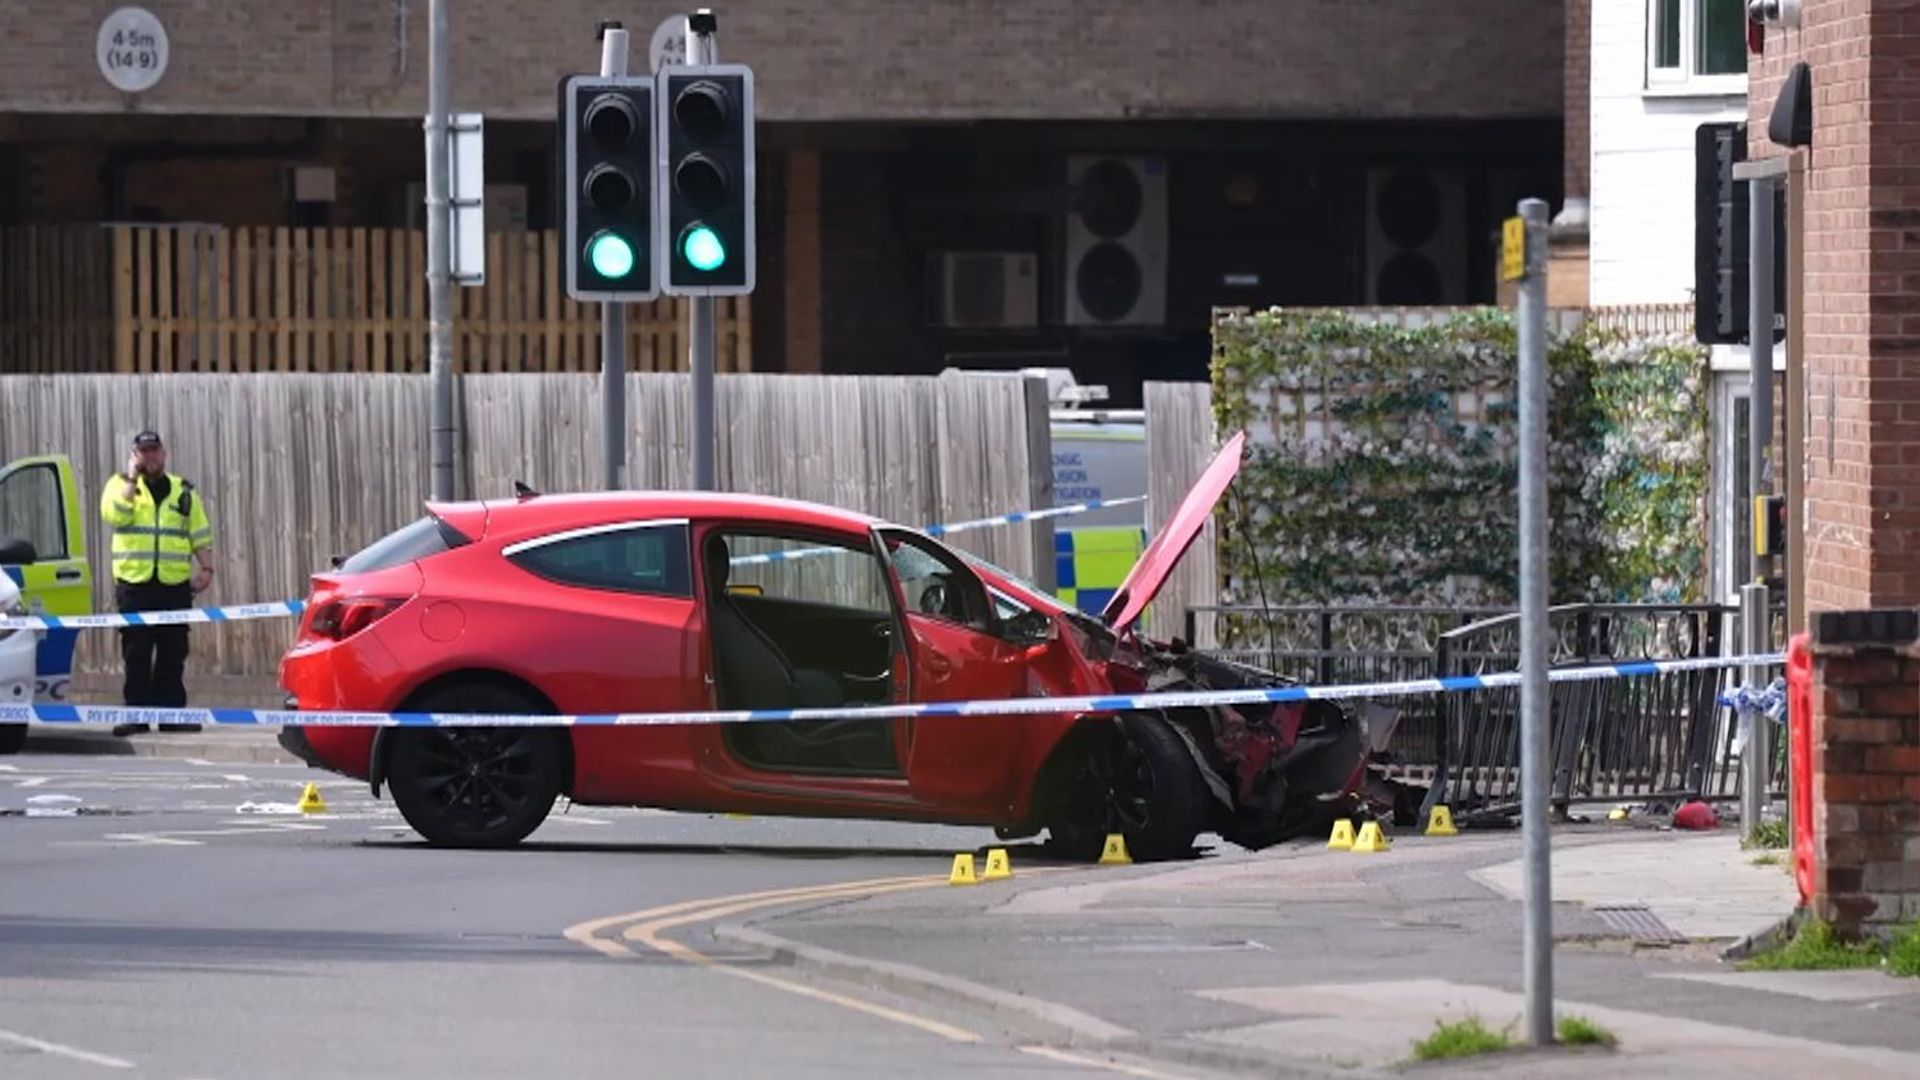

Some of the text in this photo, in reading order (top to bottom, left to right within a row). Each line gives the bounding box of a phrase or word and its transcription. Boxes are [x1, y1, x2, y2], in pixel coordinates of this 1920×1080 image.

[1435, 815, 1444, 827] 6
[993, 859, 1001, 870] 2
[960, 865, 966, 876] 1
